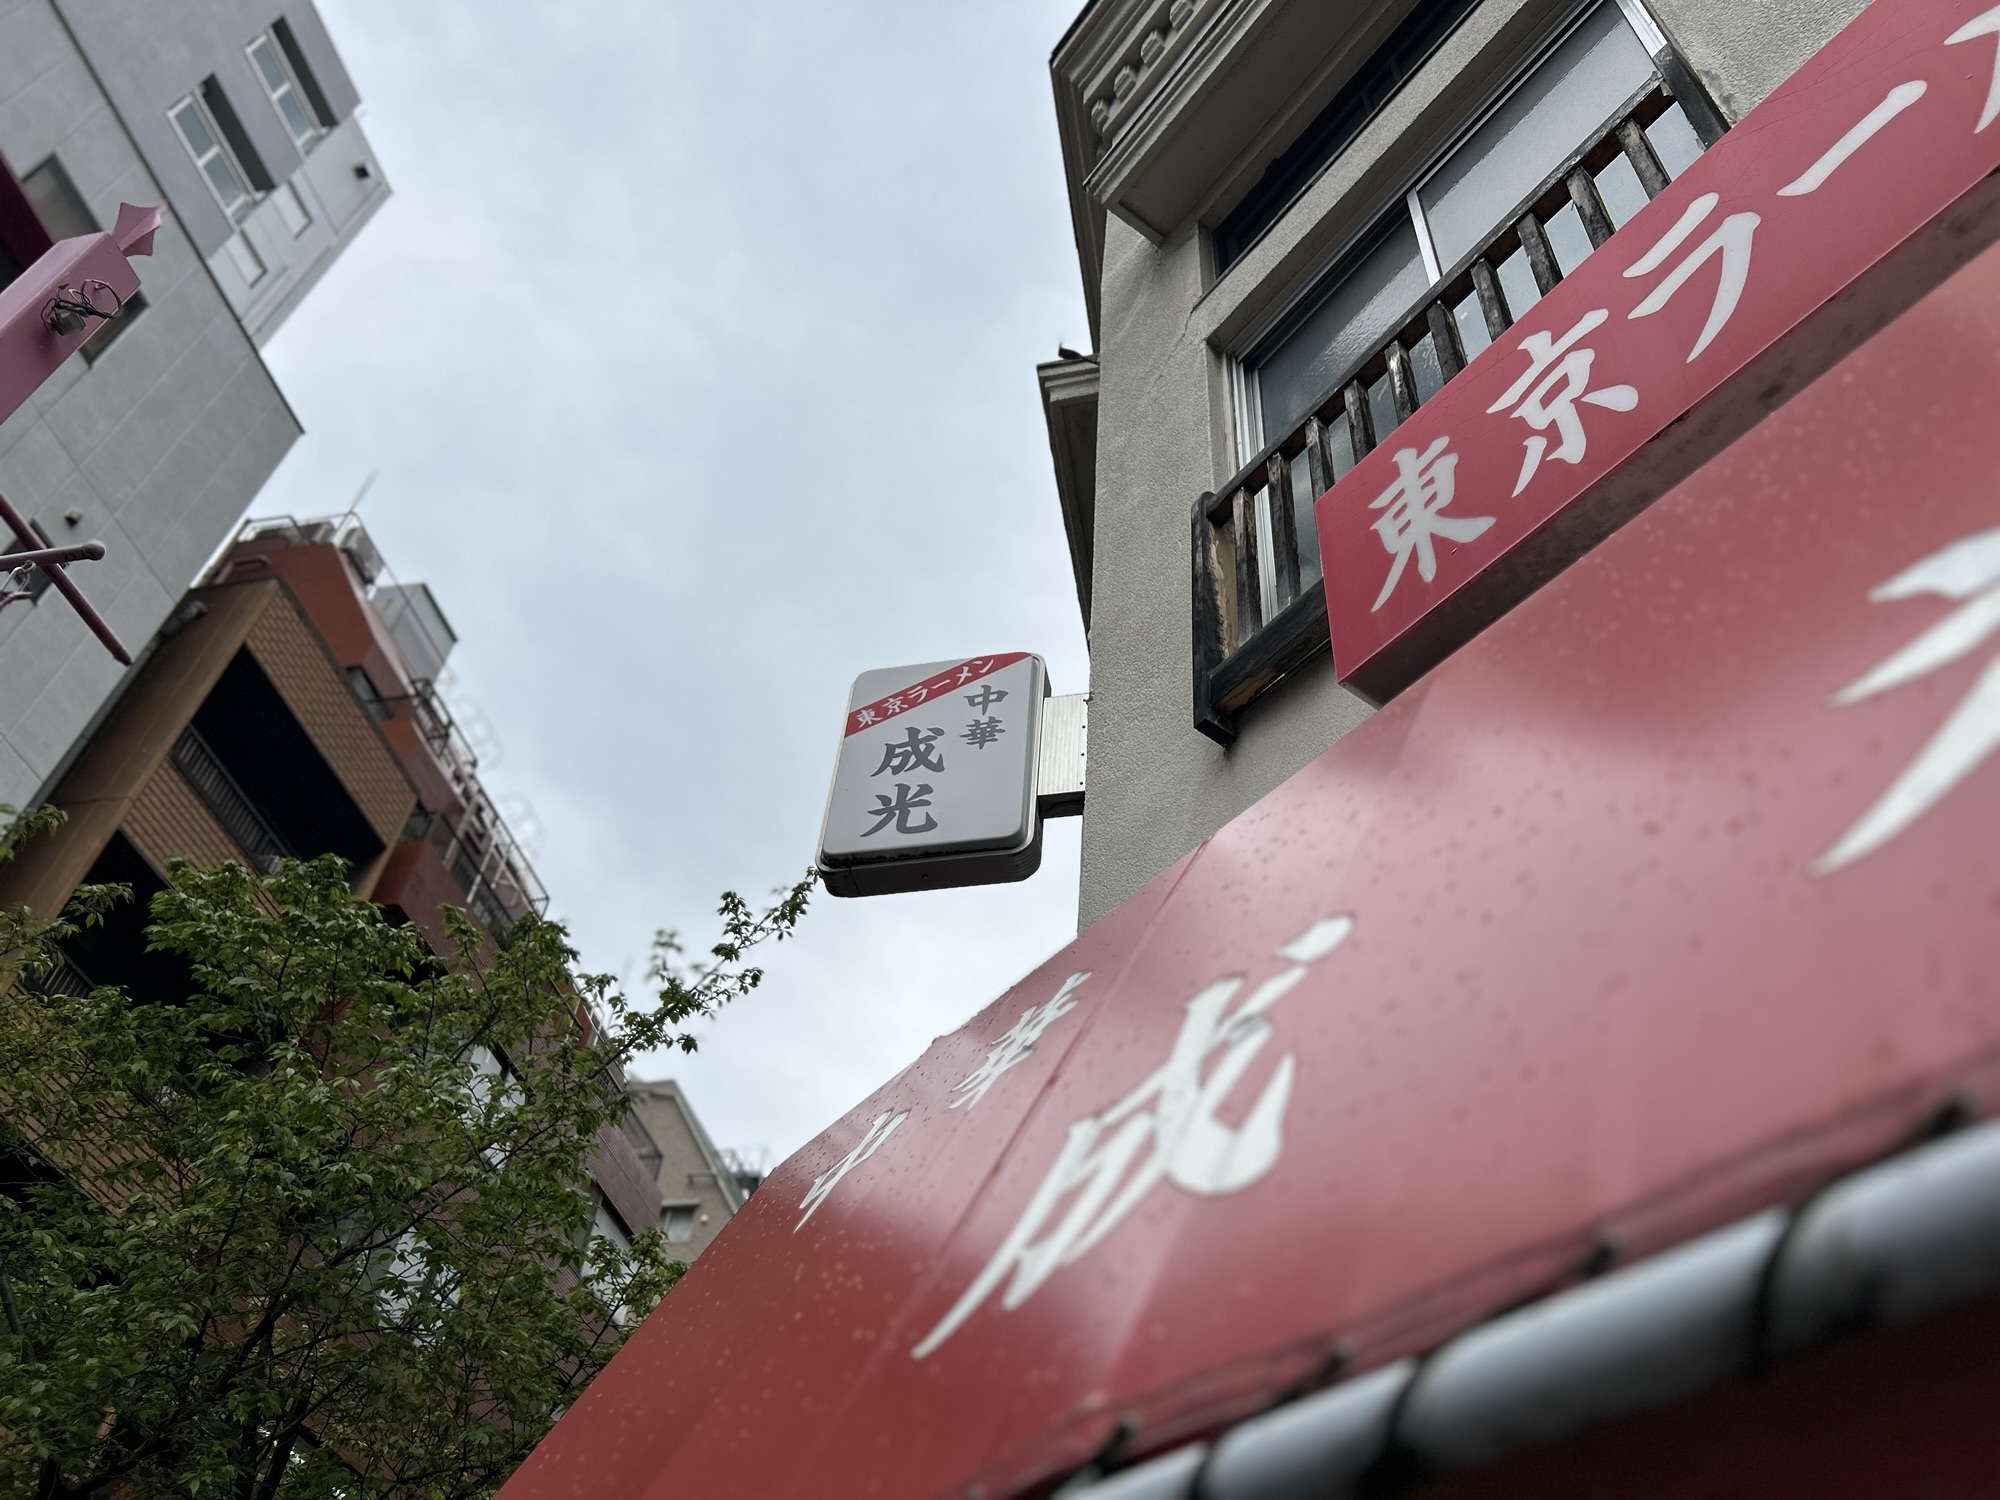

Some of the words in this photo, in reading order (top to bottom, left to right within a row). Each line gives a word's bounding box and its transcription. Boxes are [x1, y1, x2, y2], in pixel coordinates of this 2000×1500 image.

[857, 658, 994, 728] 東京ラーメン
[959, 684, 1009, 750] 中華
[860, 726, 945, 837] 成光
